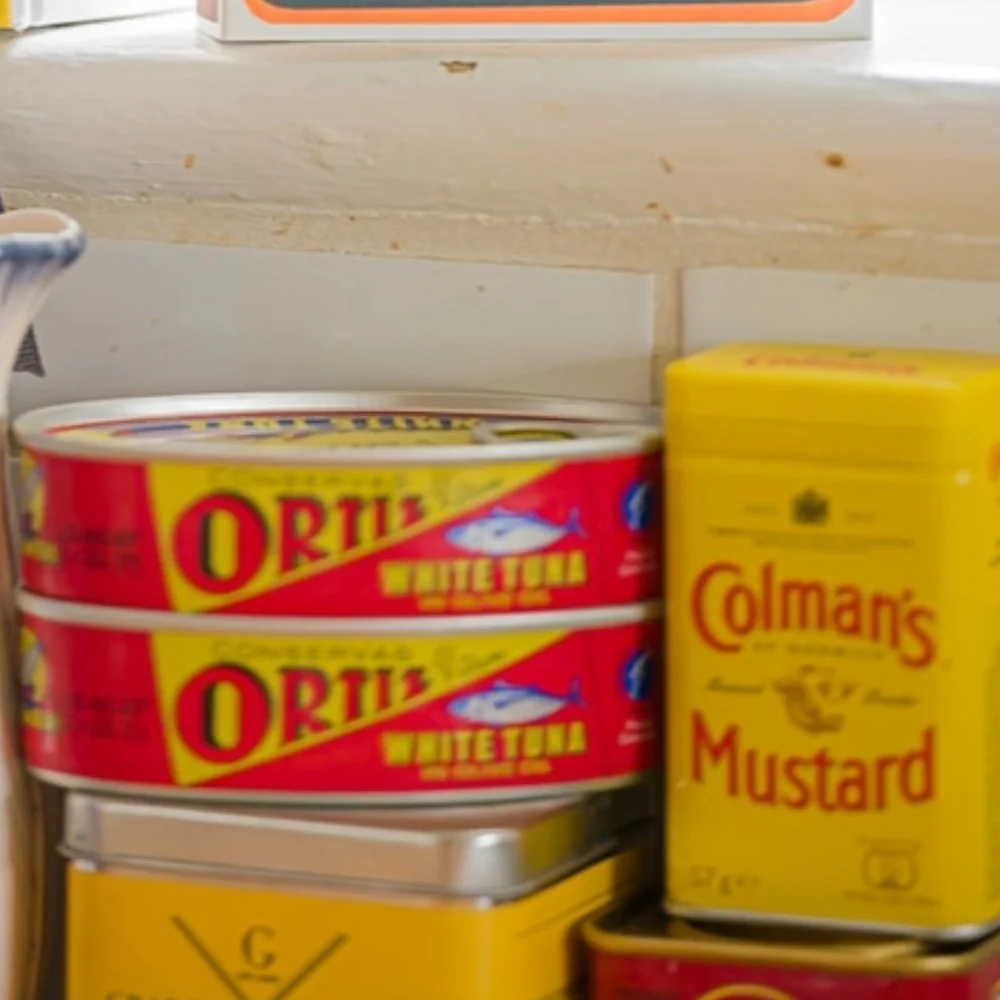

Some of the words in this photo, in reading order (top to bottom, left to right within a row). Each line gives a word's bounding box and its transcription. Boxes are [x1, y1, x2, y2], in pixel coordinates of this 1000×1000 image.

[378, 556, 494, 597] WHITE
[502, 549, 587, 589] TUNA
[690, 562, 936, 669] Colman's
[381, 728, 496, 767] WHITE
[502, 721, 587, 758] TUNA
[689, 710, 936, 814] Mustard
[240, 924, 277, 970] G
